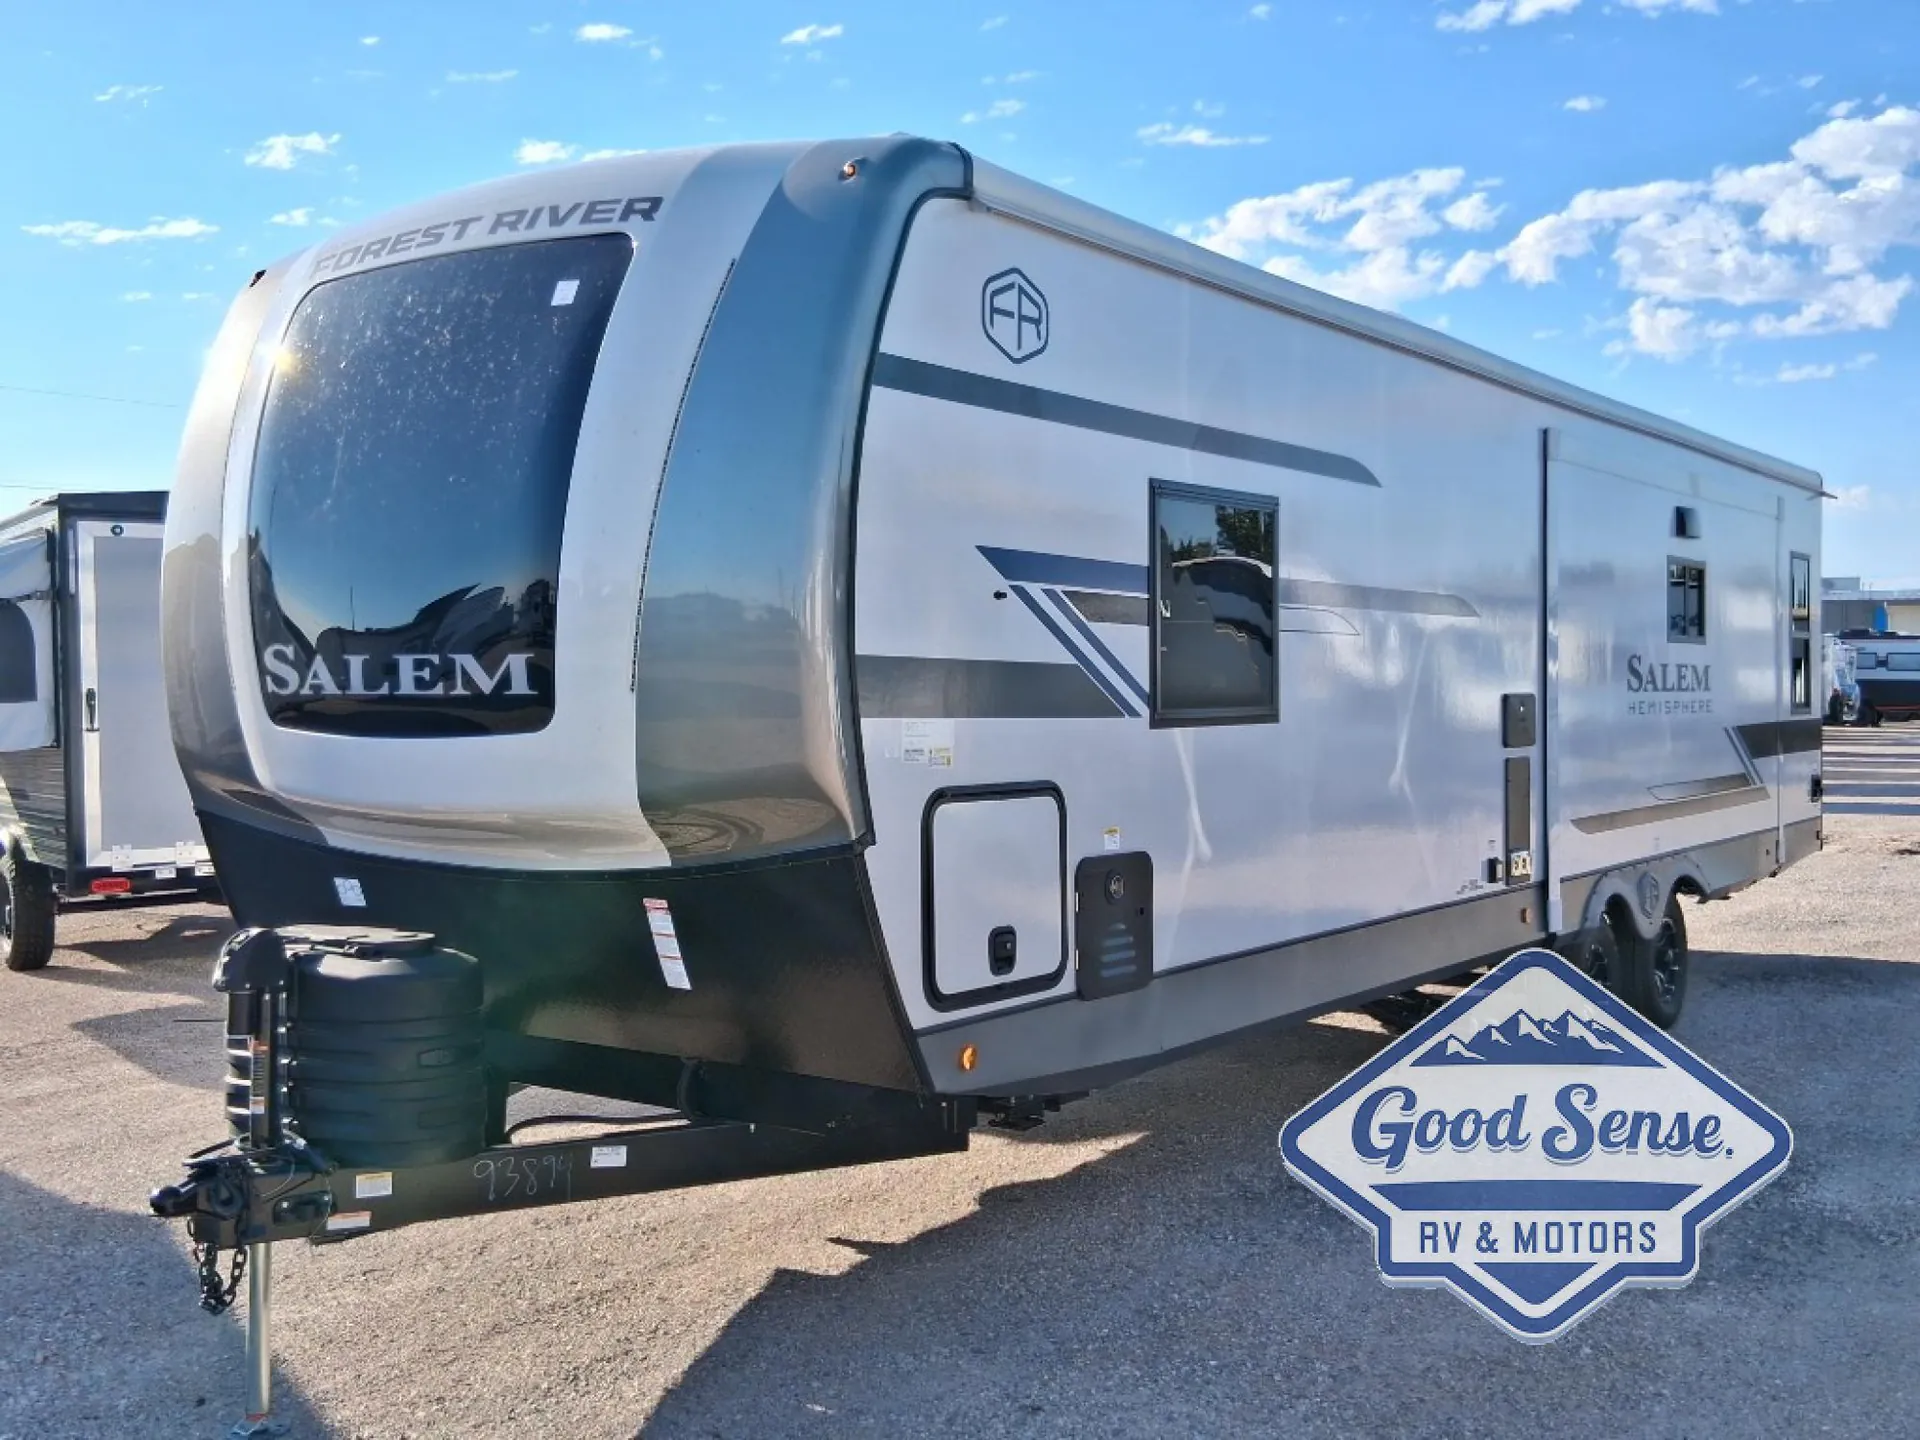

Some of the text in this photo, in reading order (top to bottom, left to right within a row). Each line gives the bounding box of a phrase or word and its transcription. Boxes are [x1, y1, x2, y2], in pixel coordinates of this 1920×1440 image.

[309, 196, 665, 281] FOREST RIVER
[262, 643, 539, 695] SALEM
[1626, 653, 1712, 692] SALEM
[1628, 699, 1714, 715] HEMISPHERE
